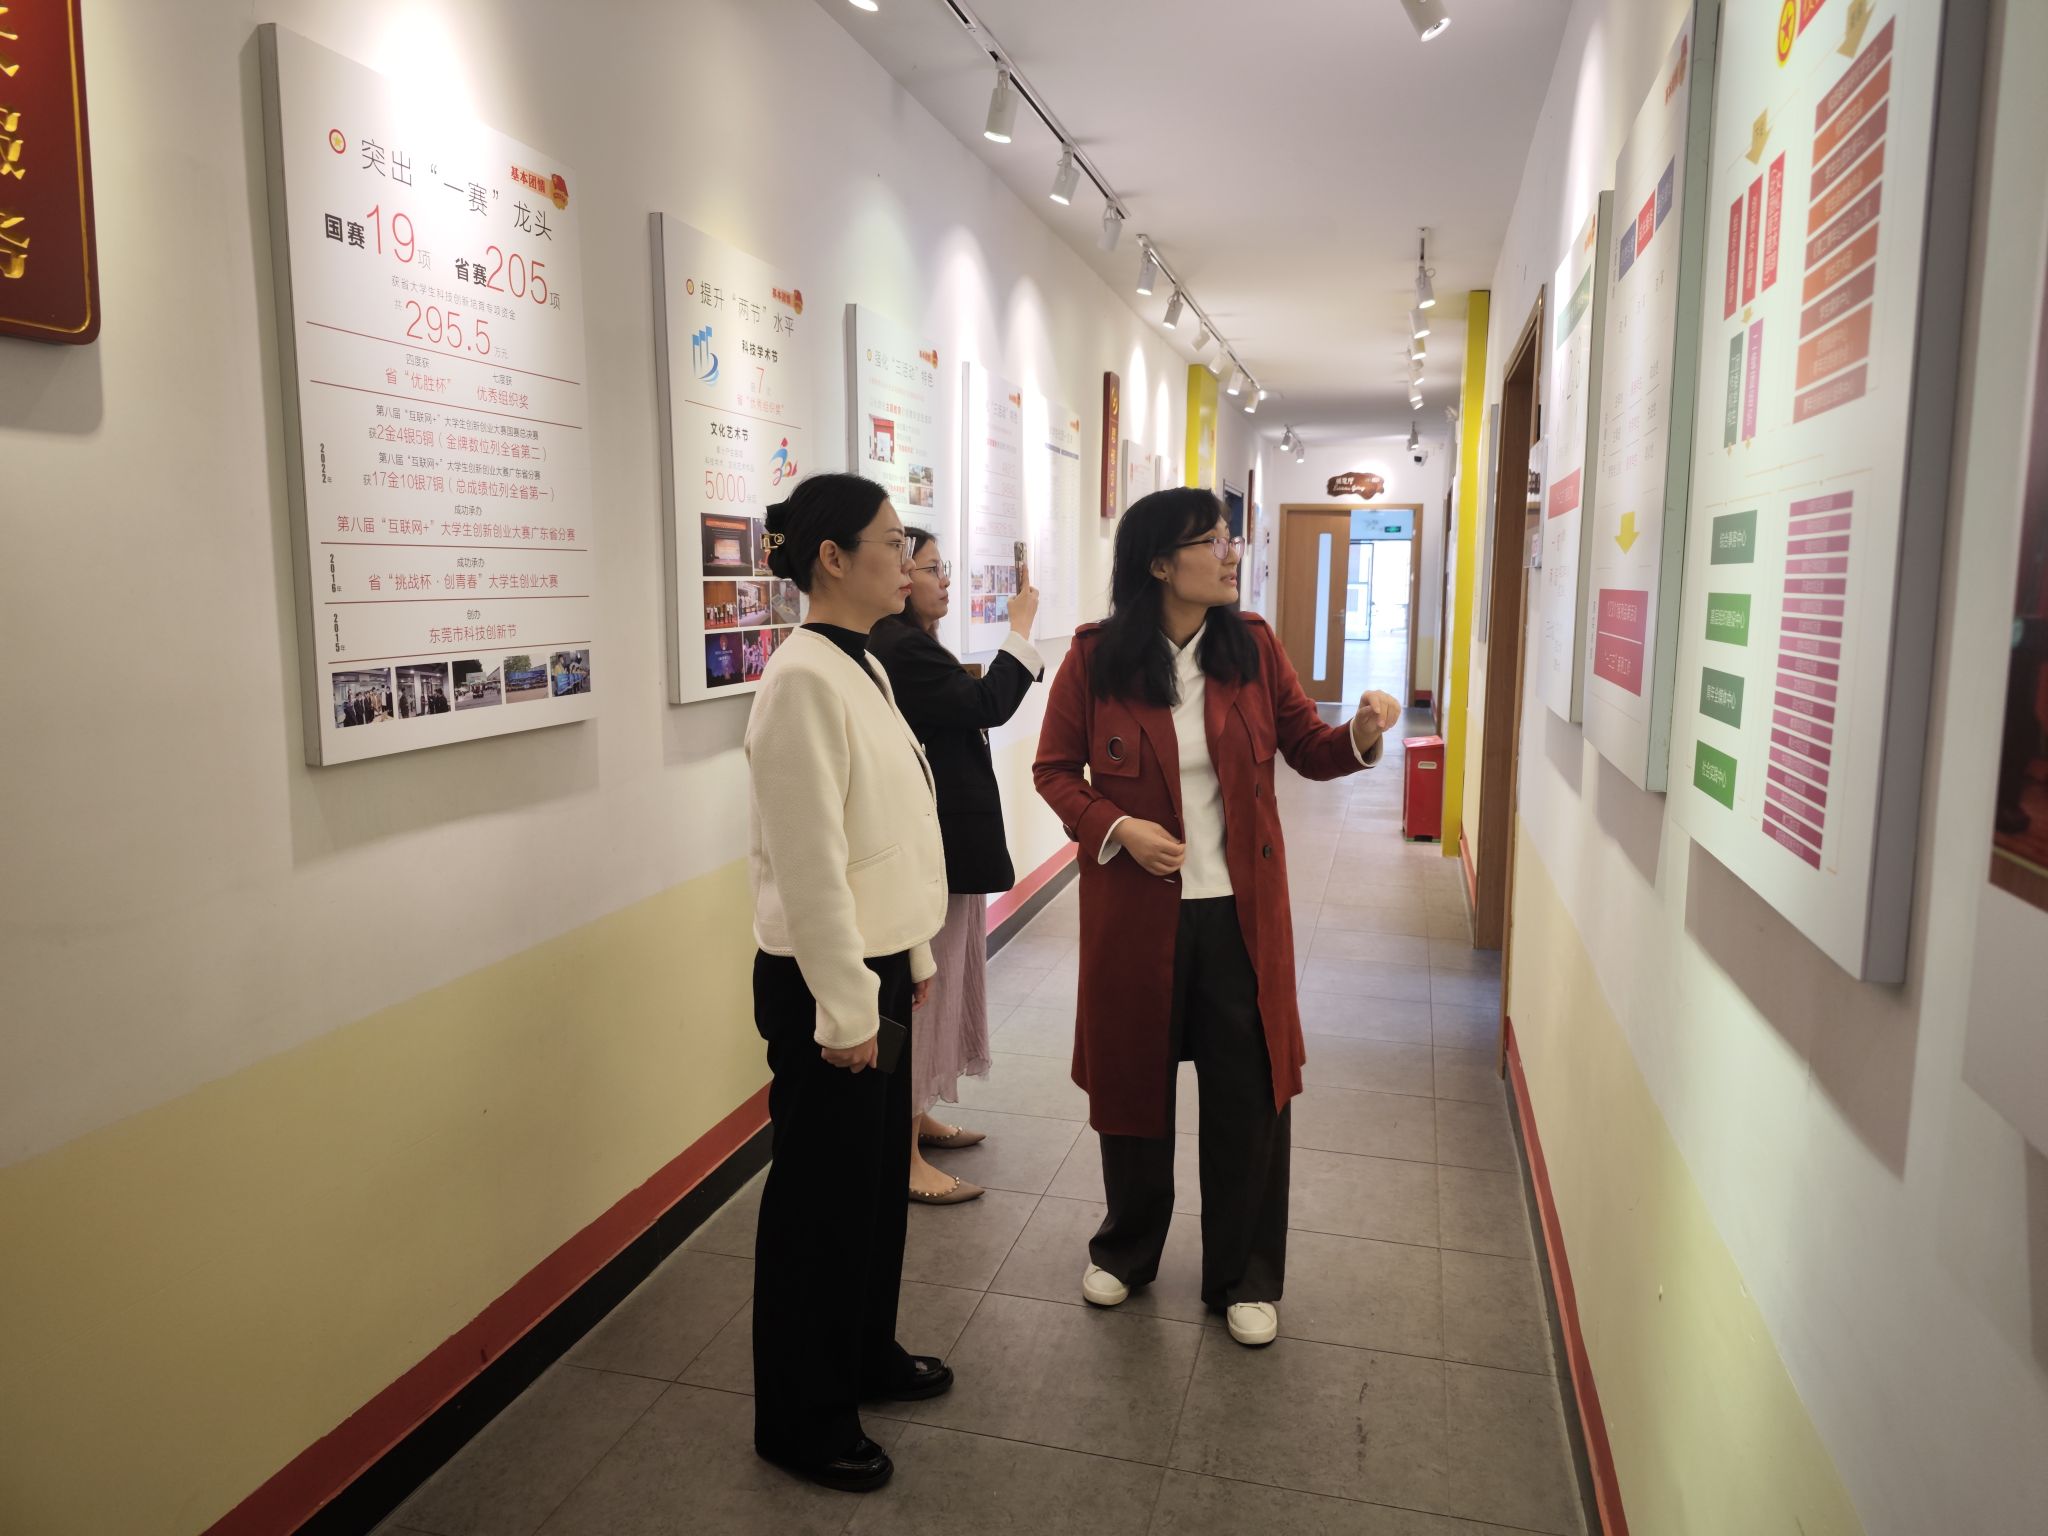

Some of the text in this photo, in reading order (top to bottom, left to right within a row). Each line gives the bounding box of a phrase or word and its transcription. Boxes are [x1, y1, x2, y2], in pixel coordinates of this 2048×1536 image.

[511, 166, 546, 194] 基本团情
[405, 353, 431, 368] 四度获
[742, 339, 778, 363] 科技学术节
[477, 386, 529, 410] 优秀组织奖
[710, 422, 749, 441] 文化艺术节
[454, 505, 482, 516] 成功承办
[456, 557, 485, 568] 成功承办
[466, 609, 482, 620] 创办
[429, 624, 517, 644] 东莞市科技创新节
